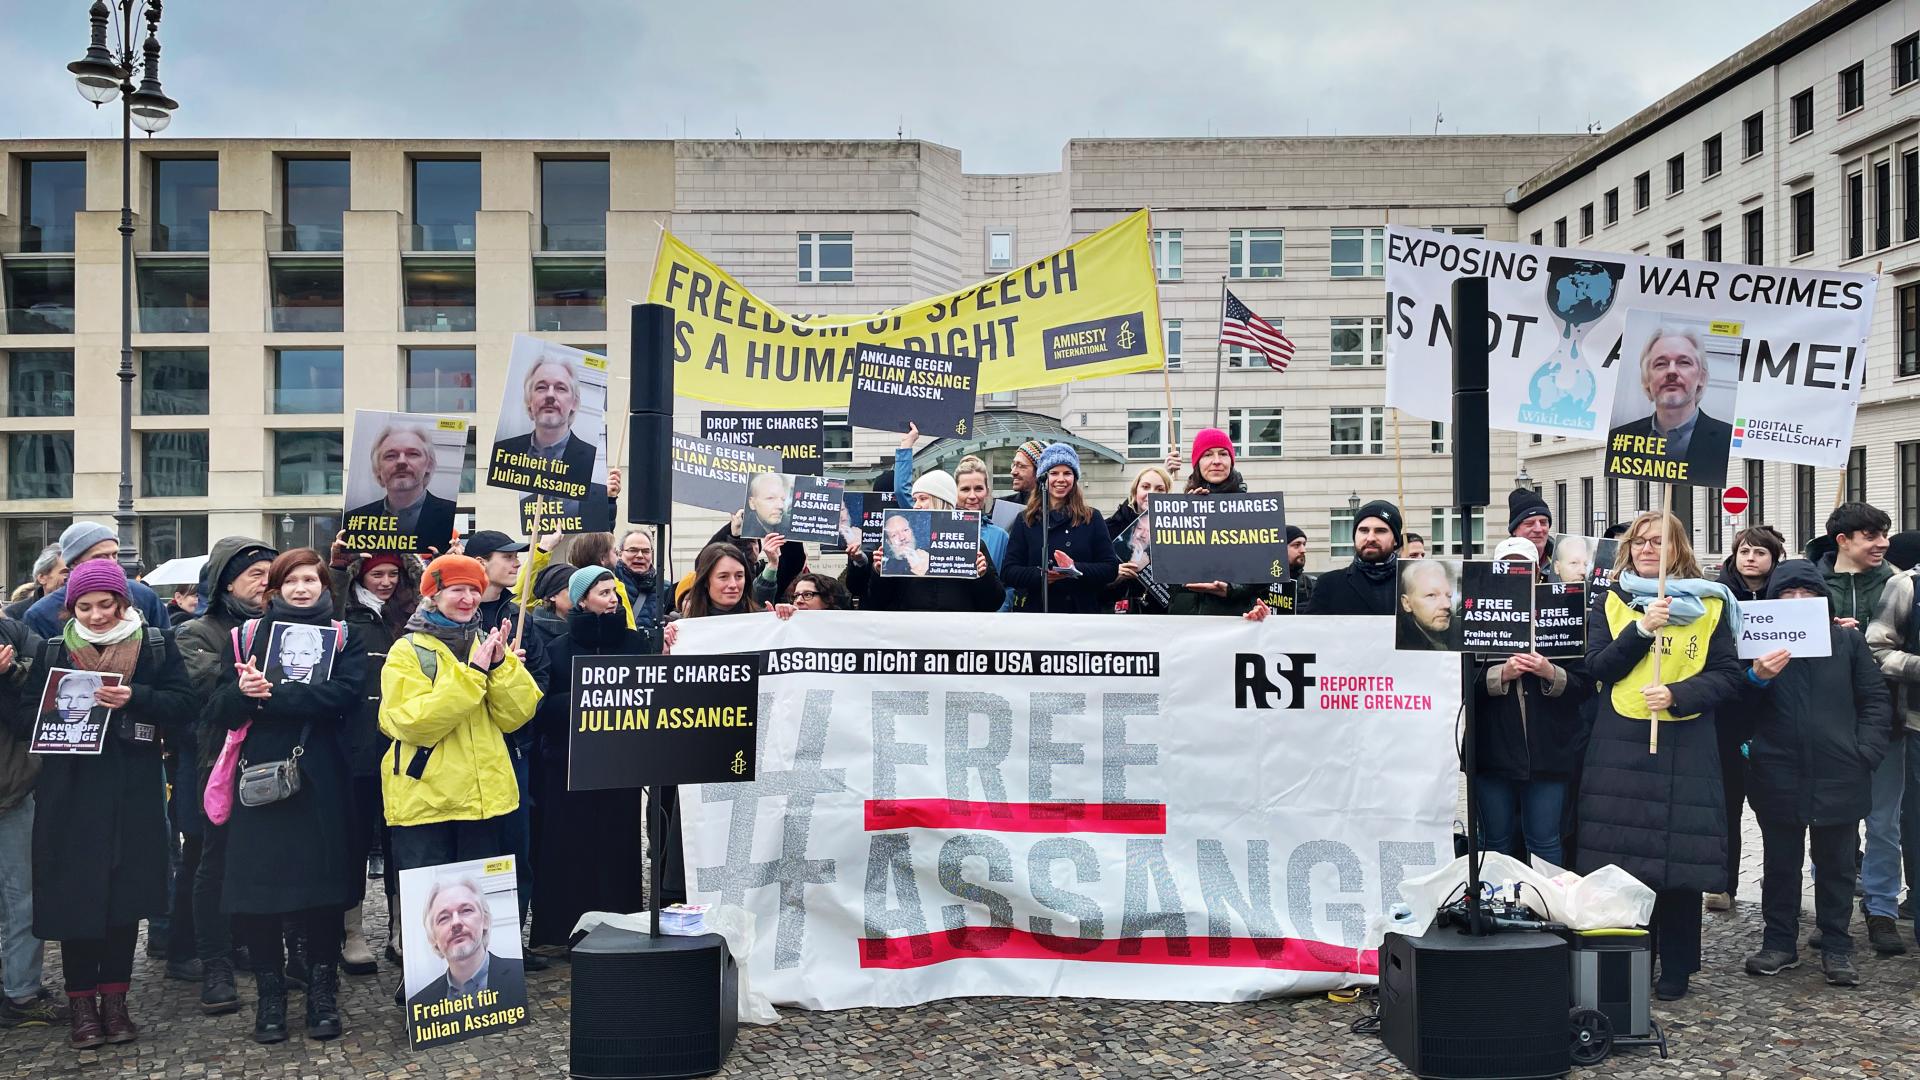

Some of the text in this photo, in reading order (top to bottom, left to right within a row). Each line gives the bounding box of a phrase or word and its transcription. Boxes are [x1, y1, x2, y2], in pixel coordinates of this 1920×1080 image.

[1388, 234, 1538, 282] EXPOSING
[1640, 265, 1864, 310] WAR CRIMES
[1386, 292, 1416, 340] IS
[1053, 328, 1106, 350] AMNESTY
[674, 320, 694, 362] S
[704, 332, 728, 374] A
[746, 340, 856, 382] HUMA
[1054, 344, 1108, 360] INTERNATIONAL
[860, 350, 952, 372] ANKLAGE GEGEN
[1739, 339, 1856, 390] IME!
[858, 363, 970, 390] JULIAN ASSANGE
[858, 378, 944, 400] FALLENLASSEN.
[706, 418, 818, 430] DROP THE CHARGES
[1521, 409, 1592, 428] WikiLeaks
[1748, 419, 1803, 434] DIGITALE
[706, 432, 754, 444] AGAINST
[1612, 433, 1667, 456] #FREE
[1748, 430, 1842, 448] GESELLSCHAFT
[672, 437, 754, 462] KLAGE GEGEN
[672, 448, 707, 466] LIAN
[758, 444, 821, 459] ANGE.
[496, 448, 570, 476] Freiheit für
[1610, 456, 1688, 480] ASSANGE
[492, 467, 586, 497] Julian Assange
[794, 500, 840, 511] ASSANGE
[804, 492, 829, 501] FREE
[1155, 499, 1278, 513] DROP THE CHARGES
[348, 516, 398, 531] #FREE
[1155, 516, 1207, 528] AGAINST
[346, 534, 418, 550] ASSANGE
[1156, 528, 1284, 545] JULIAN ASSANGE.
[1493, 562, 1510, 574] RSF
[1477, 599, 1512, 609] FREE
[1541, 608, 1569, 617] FREE
[1465, 611, 1530, 622] ASSANGE
[1535, 617, 1583, 627] ASSANGE
[1743, 613, 1773, 623] Free
[1493, 639, 1529, 648] Assange
[1742, 630, 1806, 642] Assange
[767, 651, 1154, 674] Assange nicht an die USA ausliefern!
[582, 665, 751, 684] DROP THE CHARGES
[1235, 653, 1394, 709] RSF REPORTER
[580, 688, 654, 708] AGAINST
[1320, 695, 1432, 710] OHNE GRENZEN
[578, 706, 753, 732] JULIAN ASSANGE.
[40, 732, 98, 741] ASSAGE
[872, 691, 1160, 821] FREE
[413, 989, 499, 1021] Freiheit für
[416, 1005, 525, 1043] Julian Assange
